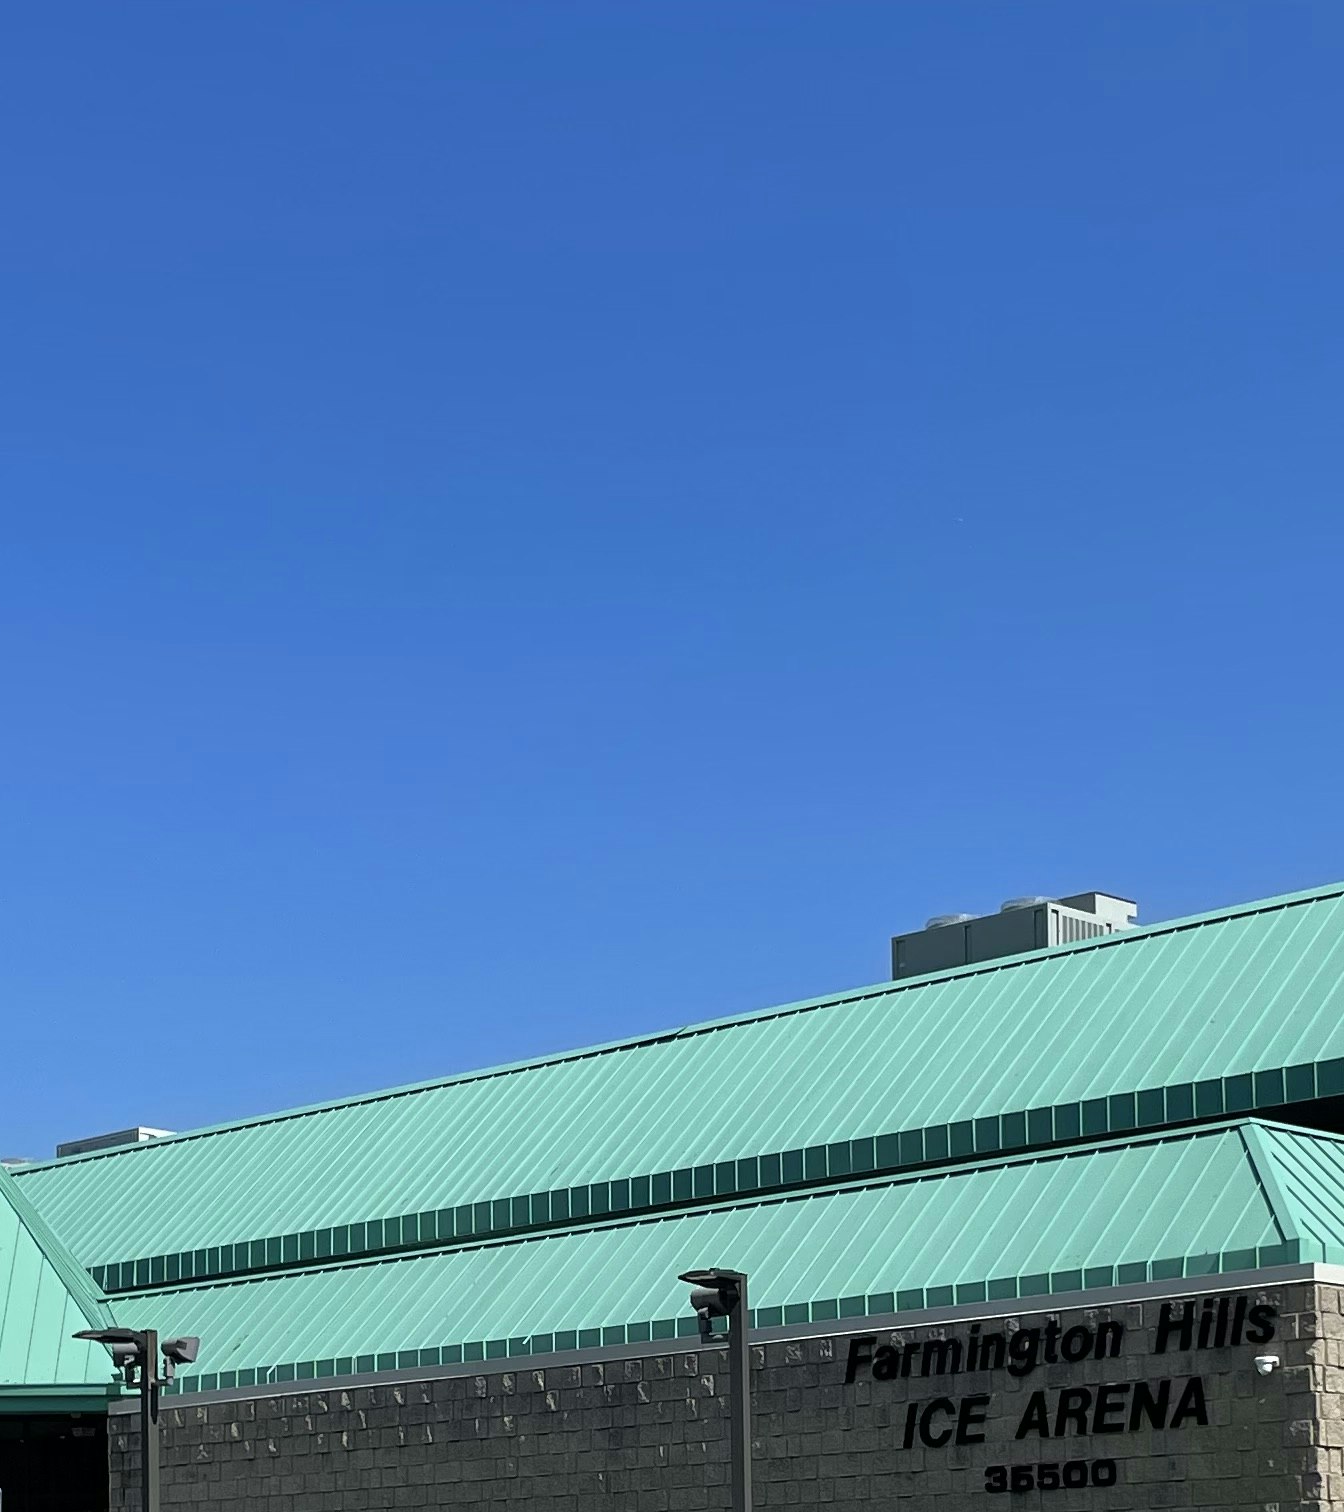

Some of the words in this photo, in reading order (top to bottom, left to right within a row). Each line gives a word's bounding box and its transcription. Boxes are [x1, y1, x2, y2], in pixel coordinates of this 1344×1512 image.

[845, 1319, 1124, 1384] Farmington
[1158, 1296, 1279, 1355] Hills
[902, 1396, 991, 1450] ICE
[1015, 1376, 1209, 1440] ARENA
[984, 1459, 1117, 1493] 35500
